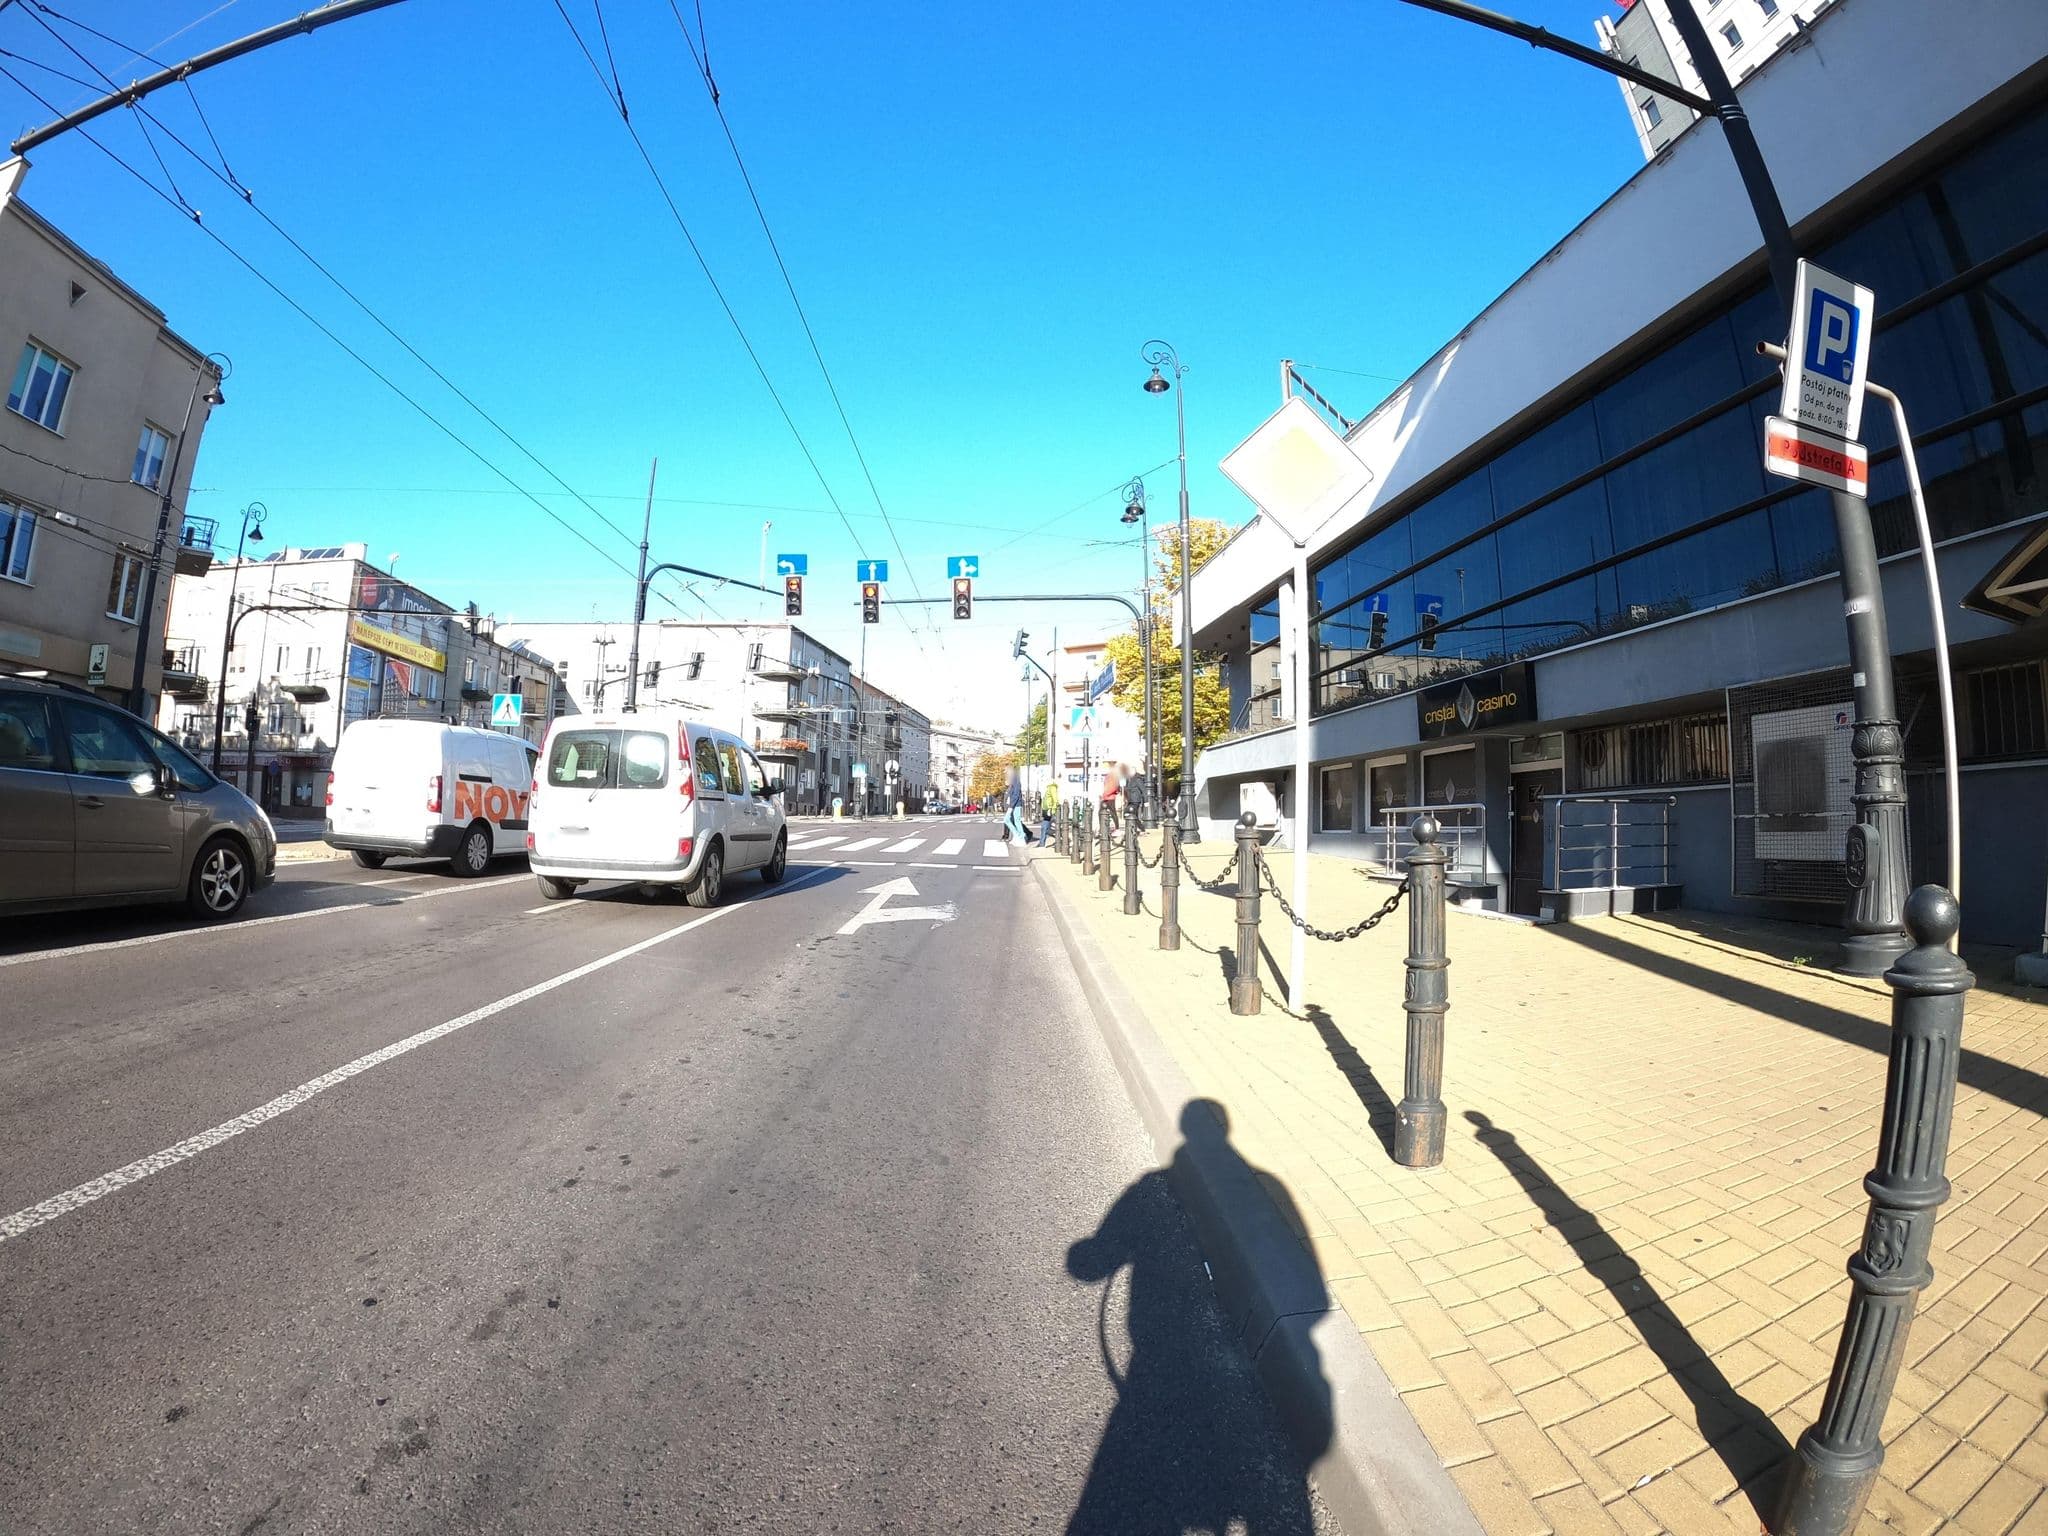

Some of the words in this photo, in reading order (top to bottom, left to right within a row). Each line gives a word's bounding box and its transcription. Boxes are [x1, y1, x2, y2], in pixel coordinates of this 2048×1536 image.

[1817, 301, 1851, 367] P
[1804, 393, 1814, 404] Od
[1826, 401, 1835, 411] do
[1847, 459, 1855, 477] A
[1476, 692, 1517, 713] casino
